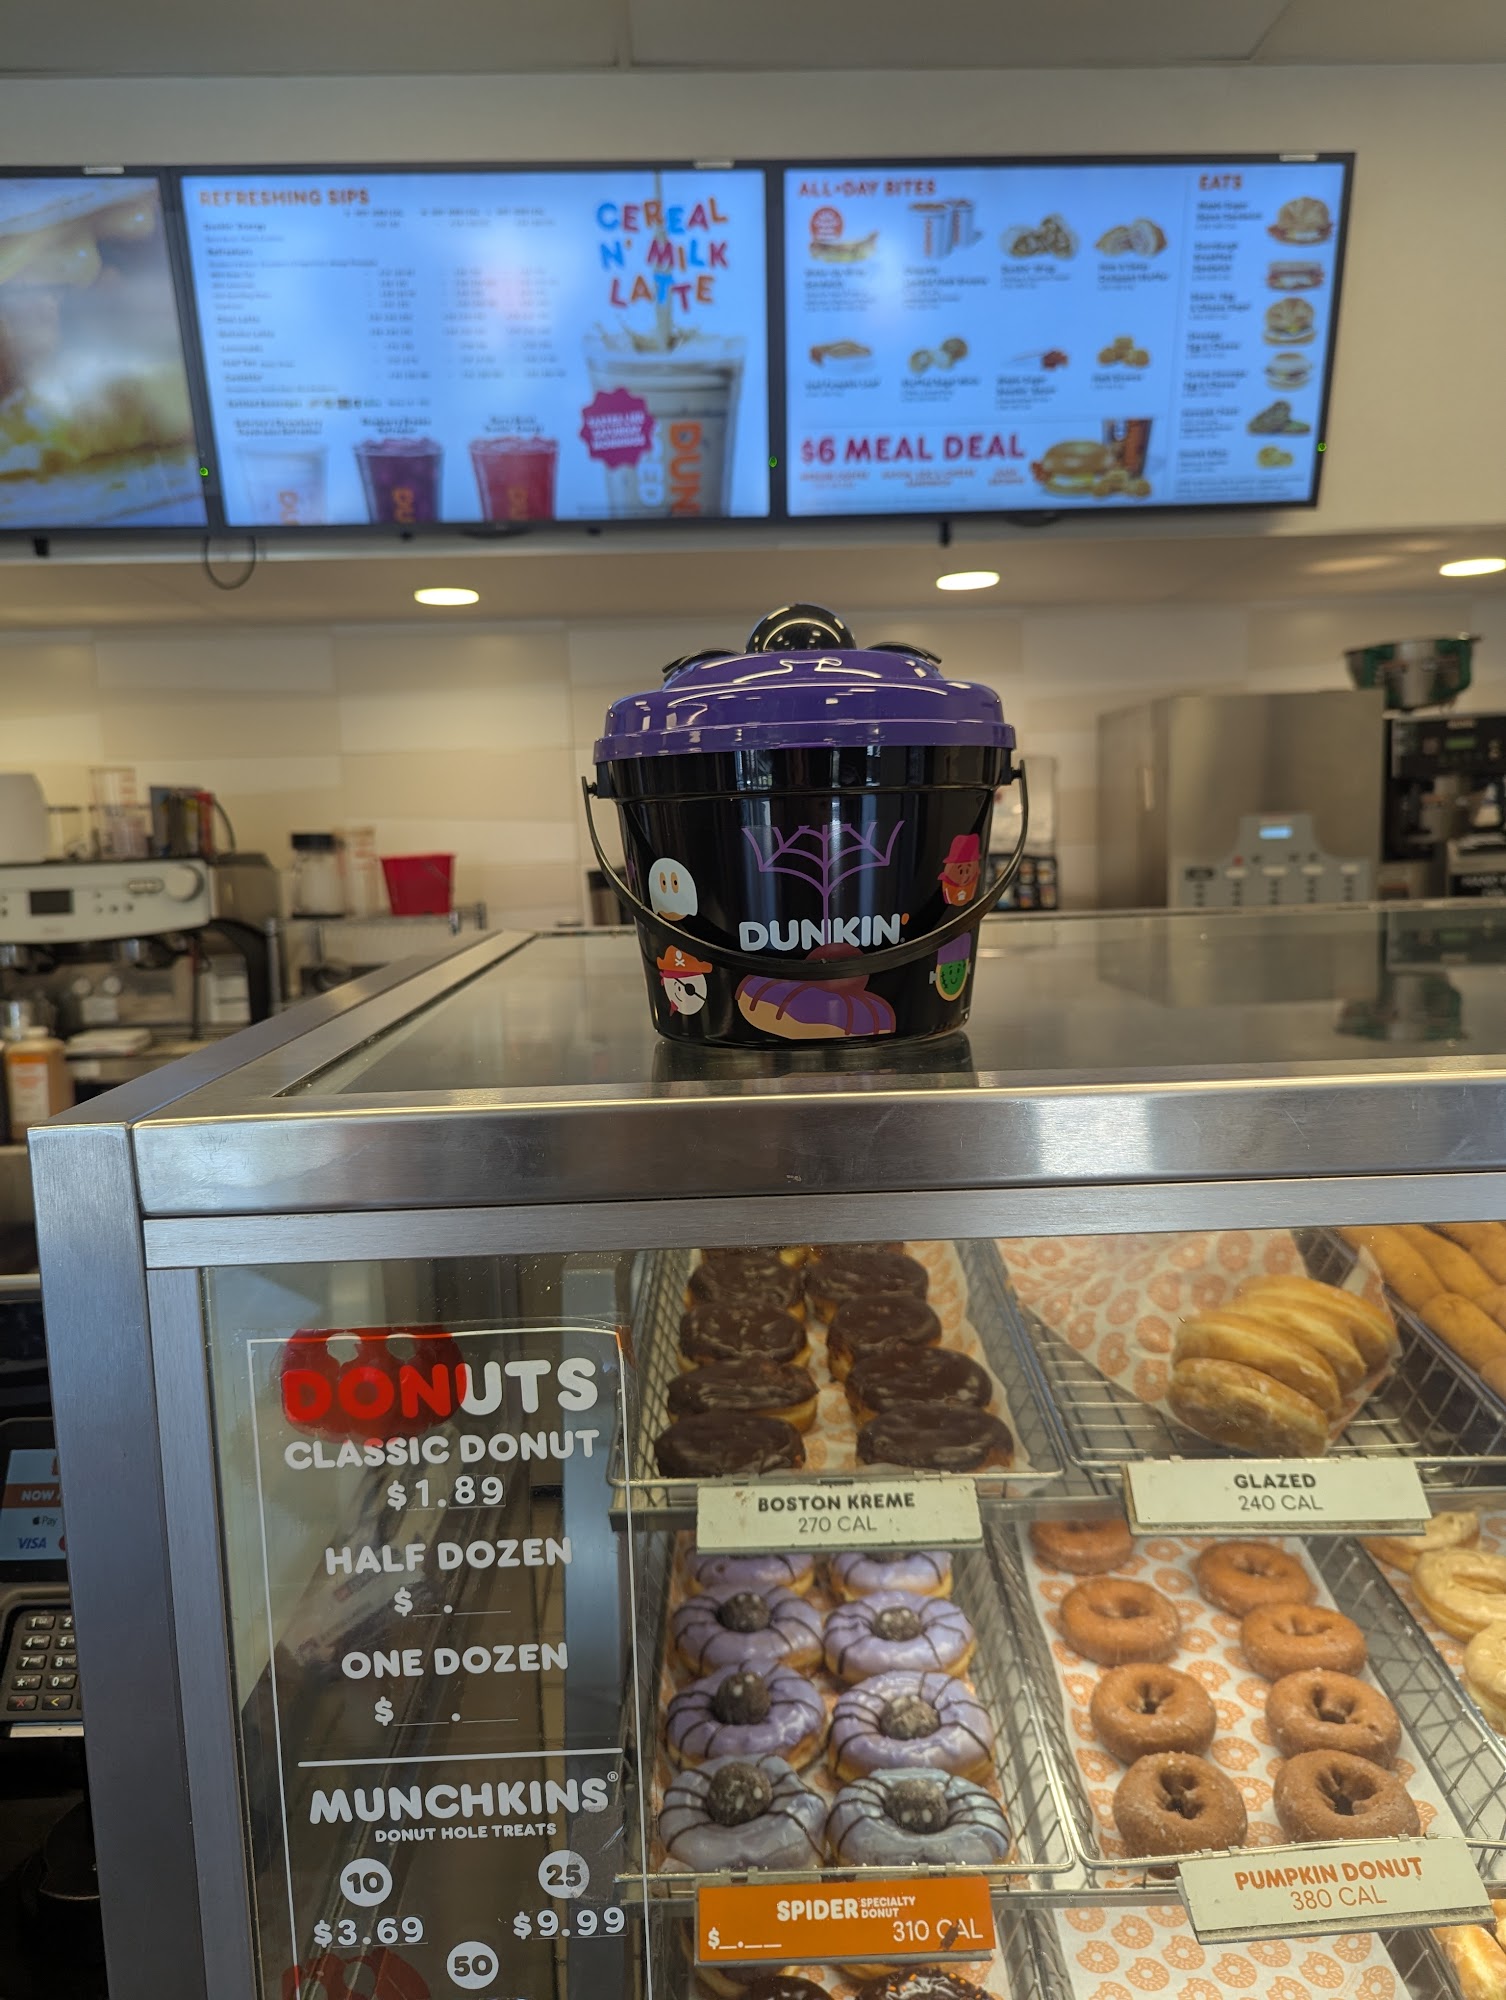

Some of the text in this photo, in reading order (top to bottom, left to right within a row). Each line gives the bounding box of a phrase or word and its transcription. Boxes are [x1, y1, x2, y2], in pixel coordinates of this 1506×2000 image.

[884, 177, 937, 196] BITES
[1199, 173, 1243, 191] EATS
[200, 188, 370, 206] REFRESHING SIPS
[597, 197, 728, 234] CEREAL
[646, 239, 729, 272] MILK
[609, 274, 715, 312] LATTE
[801, 433, 1025, 465] $6 MEAL DEAL
[281, 1356, 598, 1421] DONUTS
[284, 1429, 600, 1470] CLASSIC DONUT
[1234, 1473, 1316, 1489] GLAZED
[22, 1489, 55, 1501] NOW
[387, 1475, 505, 1511] $1.89
[758, 1492, 915, 1512] BOSTON KREME
[1238, 1495, 1324, 1511] 240 CAL
[41, 1515, 57, 1527] Pay
[798, 1515, 878, 1532] 270 CAL
[18, 1537, 47, 1549] VISA
[325, 1537, 572, 1575] HALF DOZEN
[31, 1617, 37, 1628] 1
[63, 1617, 72, 1627] 2
[25, 1637, 33, 1647] 4
[59, 1637, 68, 1647] 5
[22, 1656, 30, 1667] 7
[55, 1656, 63, 1667] 8
[341, 1642, 569, 1680] ONE DOZEN
[375, 1822, 557, 1843] DONUT HOLE TREATS
[347, 1872, 385, 1895] 10
[546, 1864, 583, 1887] 25
[1234, 1856, 1423, 1890] PUMPKIN DONUT
[777, 1896, 916, 1921] SPIDER SPECIALTY
[1290, 1885, 1388, 1911] 380 CAL
[513, 1906, 626, 1940] $9.99
[861, 1908, 899, 1918] DONUT
[313, 1916, 425, 1949] $3.69
[892, 1918, 984, 1942] 310 CAL
[453, 1954, 494, 1977] 50
